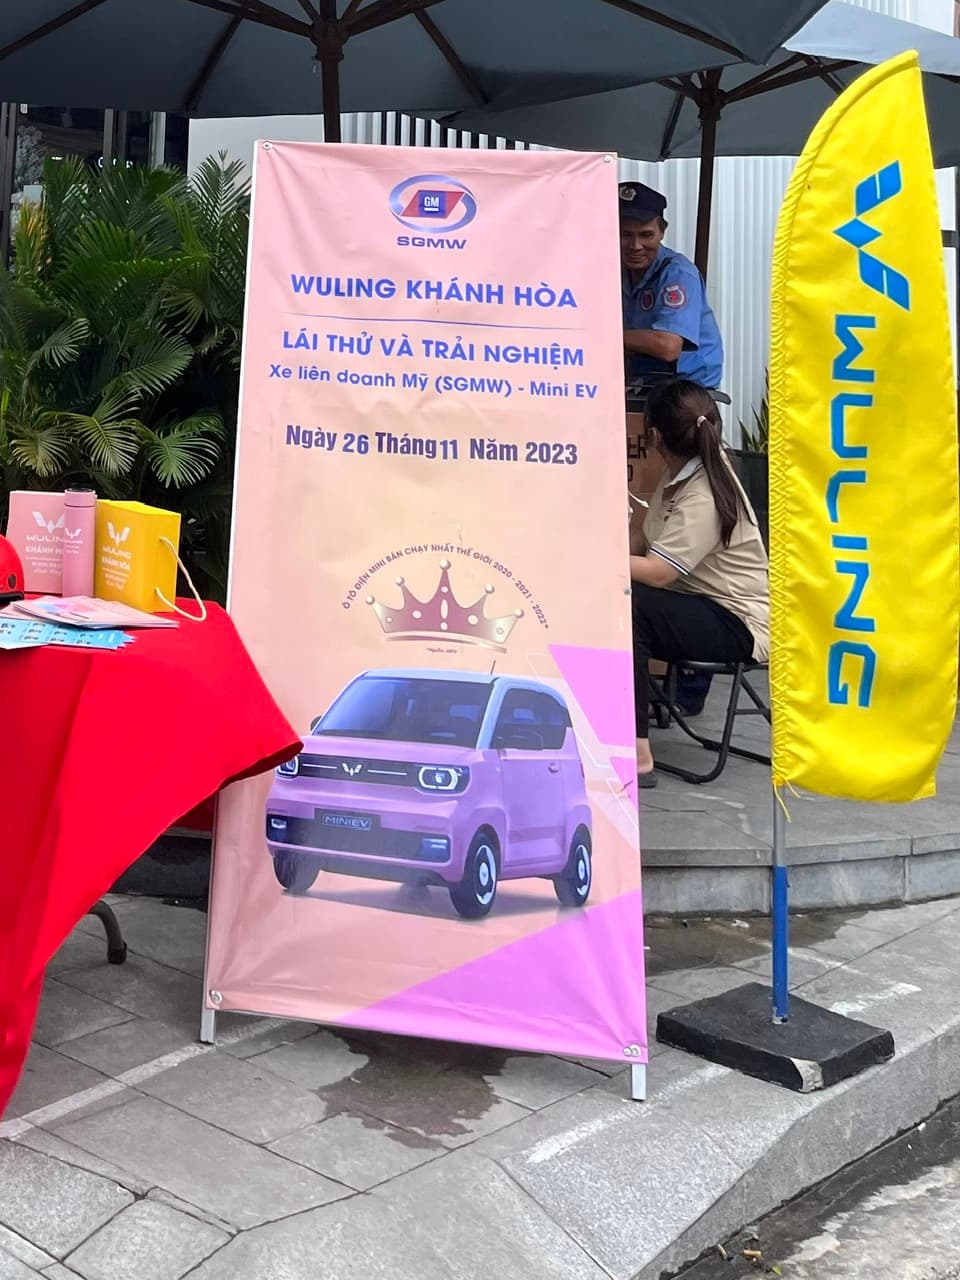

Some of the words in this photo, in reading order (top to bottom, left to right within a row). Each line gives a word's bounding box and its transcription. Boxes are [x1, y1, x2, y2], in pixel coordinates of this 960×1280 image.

[423, 195, 440, 209] GM
[396, 235, 467, 250] SGMW
[291, 274, 396, 299] WULING
[406, 277, 504, 305] KHÁNH
[514, 282, 578, 308] HÒA
[283, 328, 318, 350] LÁI
[326, 331, 373, 356] THỬ
[380, 333, 414, 357] VÀ
[422, 336, 474, 361] TRẢI
[484, 342, 584, 370] NGHIỆM
[269, 364, 292, 378] Xe
[298, 366, 330, 381] liên
[337, 369, 396, 388] doanh
[402, 373, 429, 392] Mỹ
[435, 375, 512, 398] (SGMW)
[530, 380, 569, 397] Mini
[575, 383, 598, 399] EV
[286, 424, 337, 451] Ngày
[342, 432, 370, 455] 26
[375, 432, 437, 459] Tháng
[440, 439, 458, 460] 11
[470, 438, 518, 462] Năm
[525, 441, 578, 465] 2023
[825, 314, 877, 708] WULING
[25, 534, 64, 543] WULIN
[368, 559, 387, 575] MINI
[385, 550, 404, 563] BÁN
[404, 543, 429, 555] CHẠY
[431, 542, 455, 553] NHẤT
[456, 545, 474, 557] THẾ
[493, 561, 513, 578] 2020
[514, 580, 533, 599] 2021
